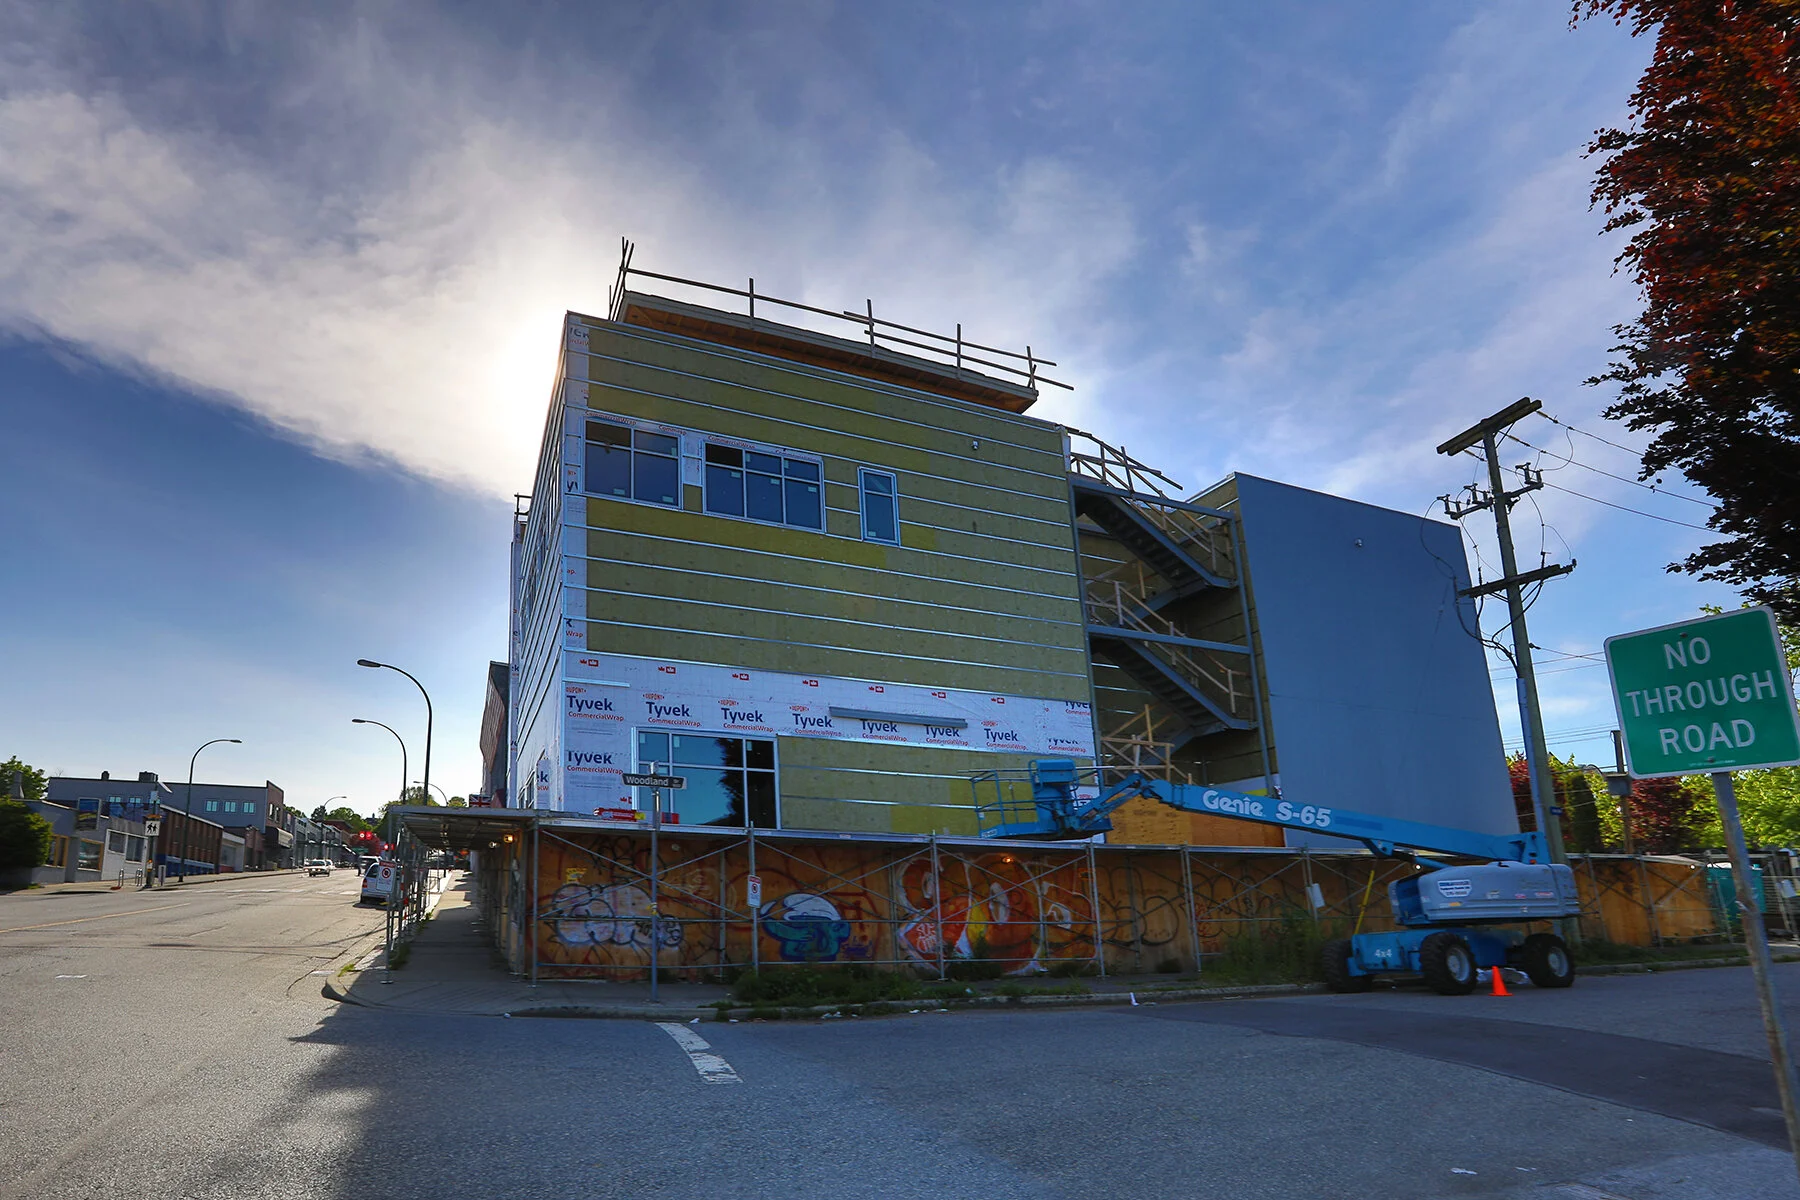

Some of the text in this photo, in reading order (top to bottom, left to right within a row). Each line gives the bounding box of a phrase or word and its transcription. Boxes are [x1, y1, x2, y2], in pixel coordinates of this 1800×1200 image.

[1663, 637, 1711, 670] NO
[1625, 669, 1778, 717] THROUGH
[566, 695, 613, 712] Tyvek
[645, 701, 690, 718] Tyvek
[568, 711, 625, 722] CommercialWrap
[647, 717, 702, 727] CommercialWrap
[721, 707, 764, 723] Tyvek
[792, 713, 833, 729] Tyvek
[723, 722, 774, 733] CommercialWrap
[861, 718, 899, 734] Tyvek
[924, 724, 961, 739] Tyvek
[862, 732, 908, 743] CommercialWrap
[984, 728, 1019, 743] Tyvek
[1658, 719, 1756, 756] ROAD
[566, 750, 613, 766] Tyvek
[566, 765, 624, 775] CommercialWrap
[626, 775, 670, 786] Woodland
[1203, 790, 1332, 827] Genie S-65
